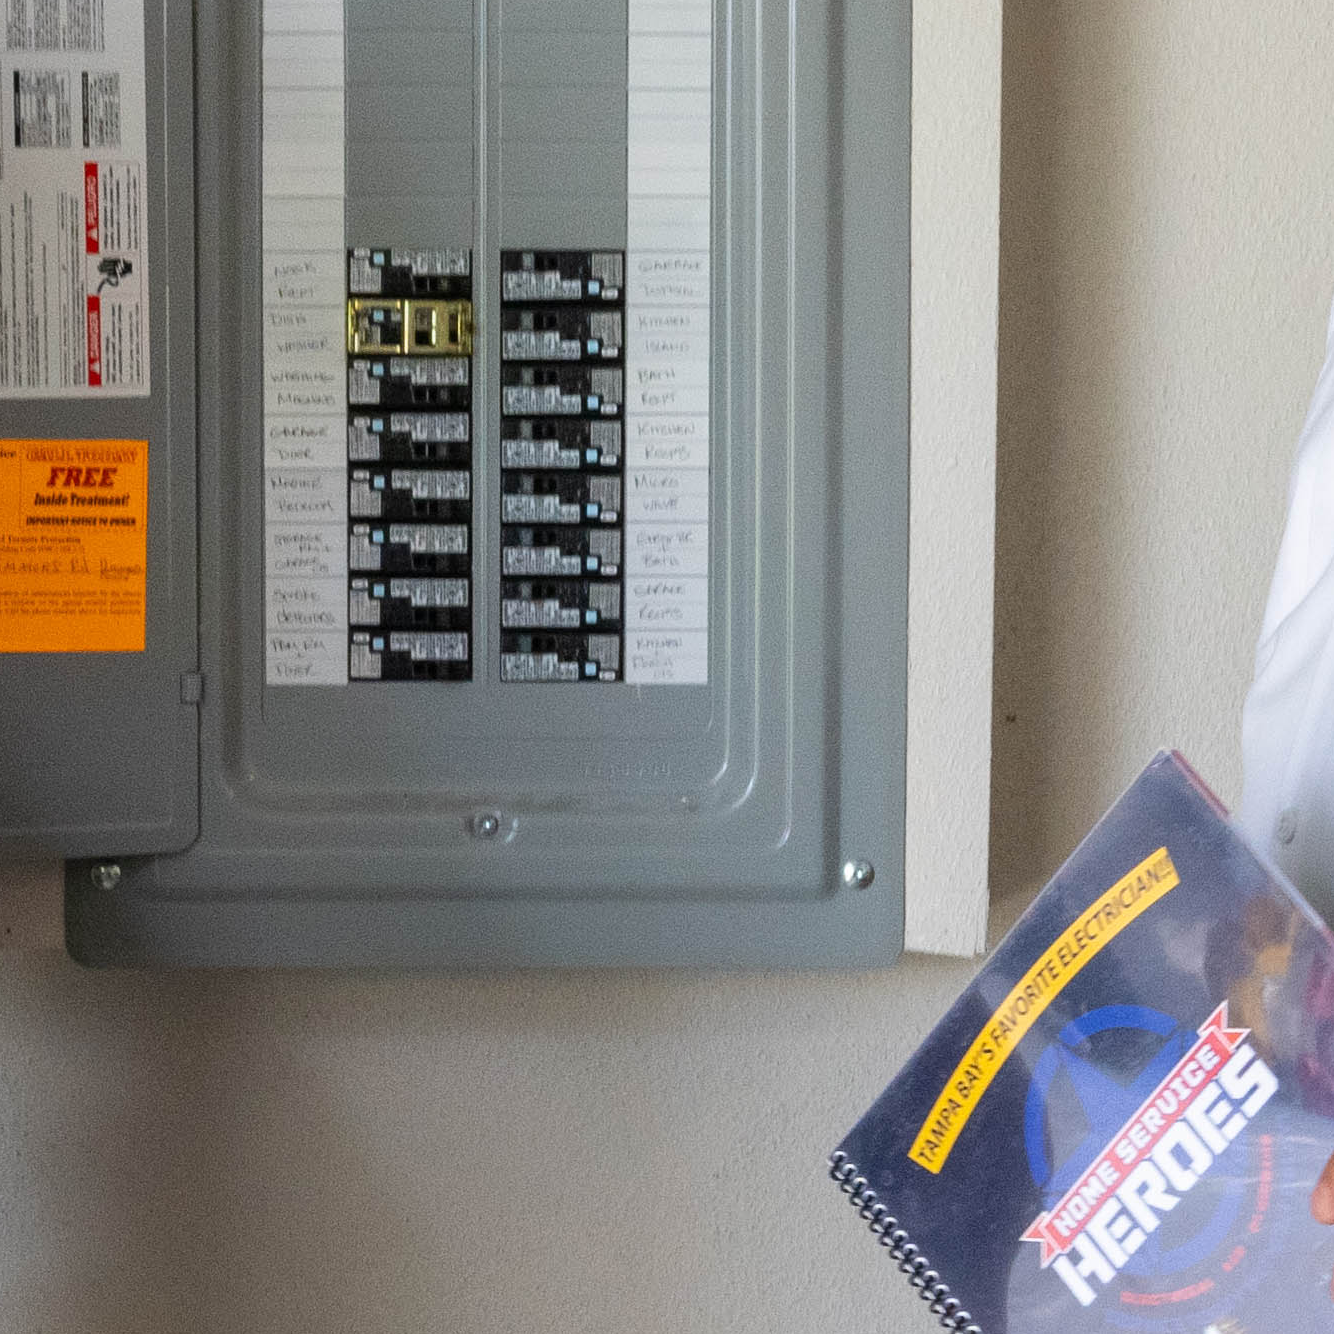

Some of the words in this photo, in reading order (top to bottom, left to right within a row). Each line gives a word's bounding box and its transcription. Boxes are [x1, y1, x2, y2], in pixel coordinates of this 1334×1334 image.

[34, 492, 68, 507] Inside
[70, 492, 131, 508] Treatment!
[46, 466, 118, 488] FREE
[918, 1097, 963, 1164] TAMPA
[955, 1042, 996, 1100] BAY'S
[990, 960, 1060, 1051] FAVORITE
[1052, 1160, 1122, 1238] HOME
[1115, 1043, 1222, 1167] SERVICE
[1051, 1042, 1279, 1307] HEROES
